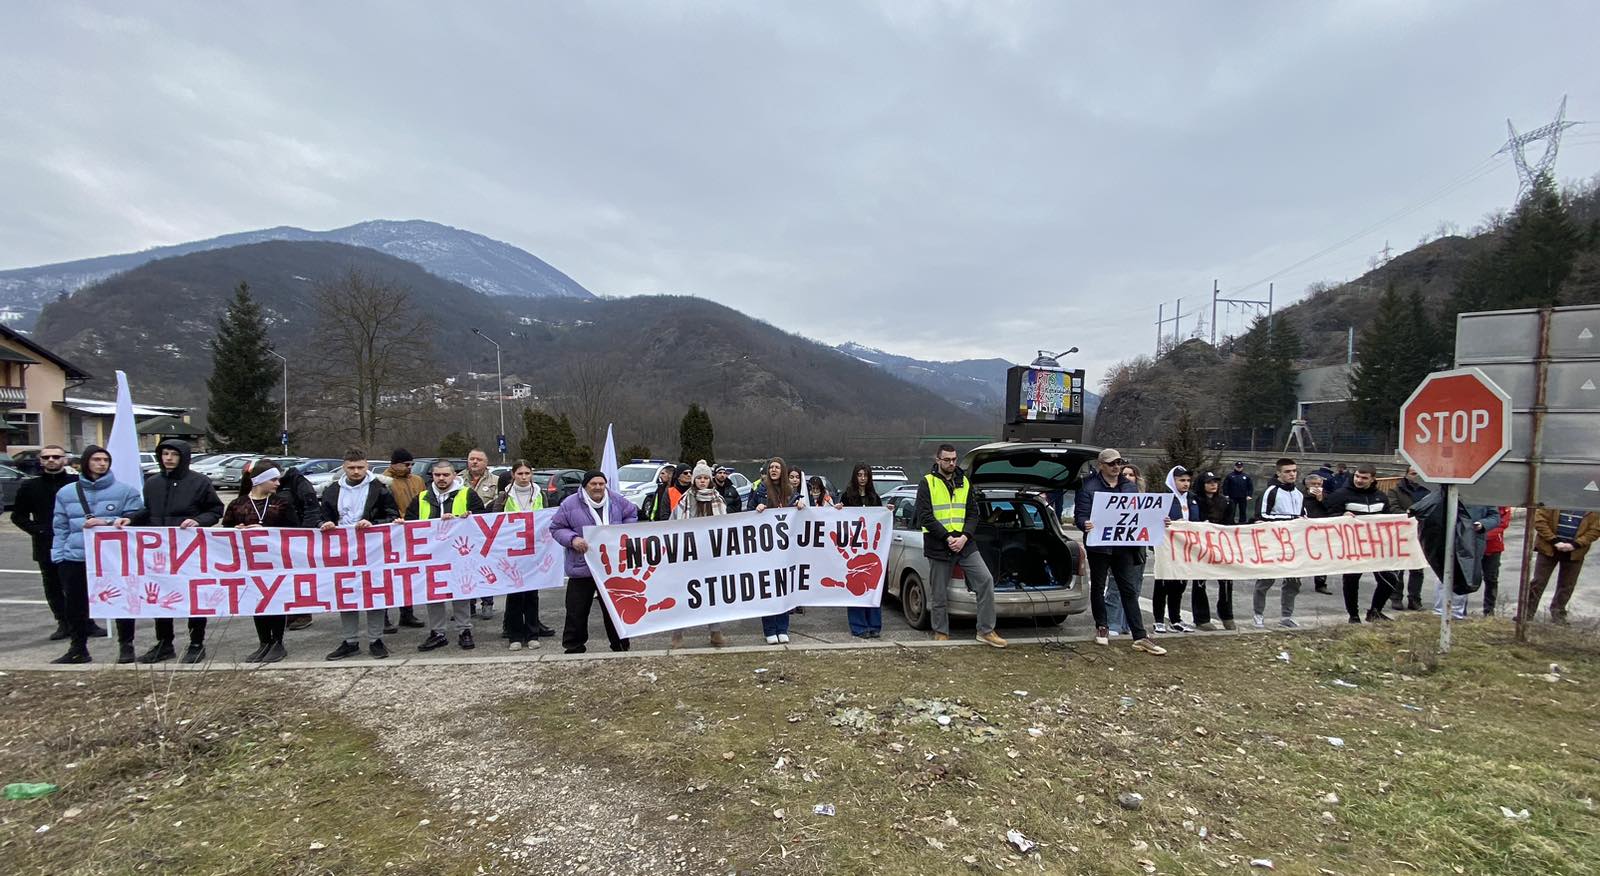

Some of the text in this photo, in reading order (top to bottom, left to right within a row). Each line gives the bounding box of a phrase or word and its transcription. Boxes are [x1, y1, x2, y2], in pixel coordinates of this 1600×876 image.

[1415, 409, 1489, 444] STOP
[1105, 496, 1163, 510] PRAVDA
[1116, 512, 1139, 526] ZA
[94, 511, 536, 577] ПРИЈЕПОЉЕ УЗ
[625, 513, 864, 570] NOVA VAROŠ JE UZ
[1101, 526, 1150, 542] ERKA
[1305, 521, 1411, 561] СТУДЕНТЕ
[189, 563, 454, 616] СТУДЕНТЕ
[687, 564, 811, 610] STUDENTE
